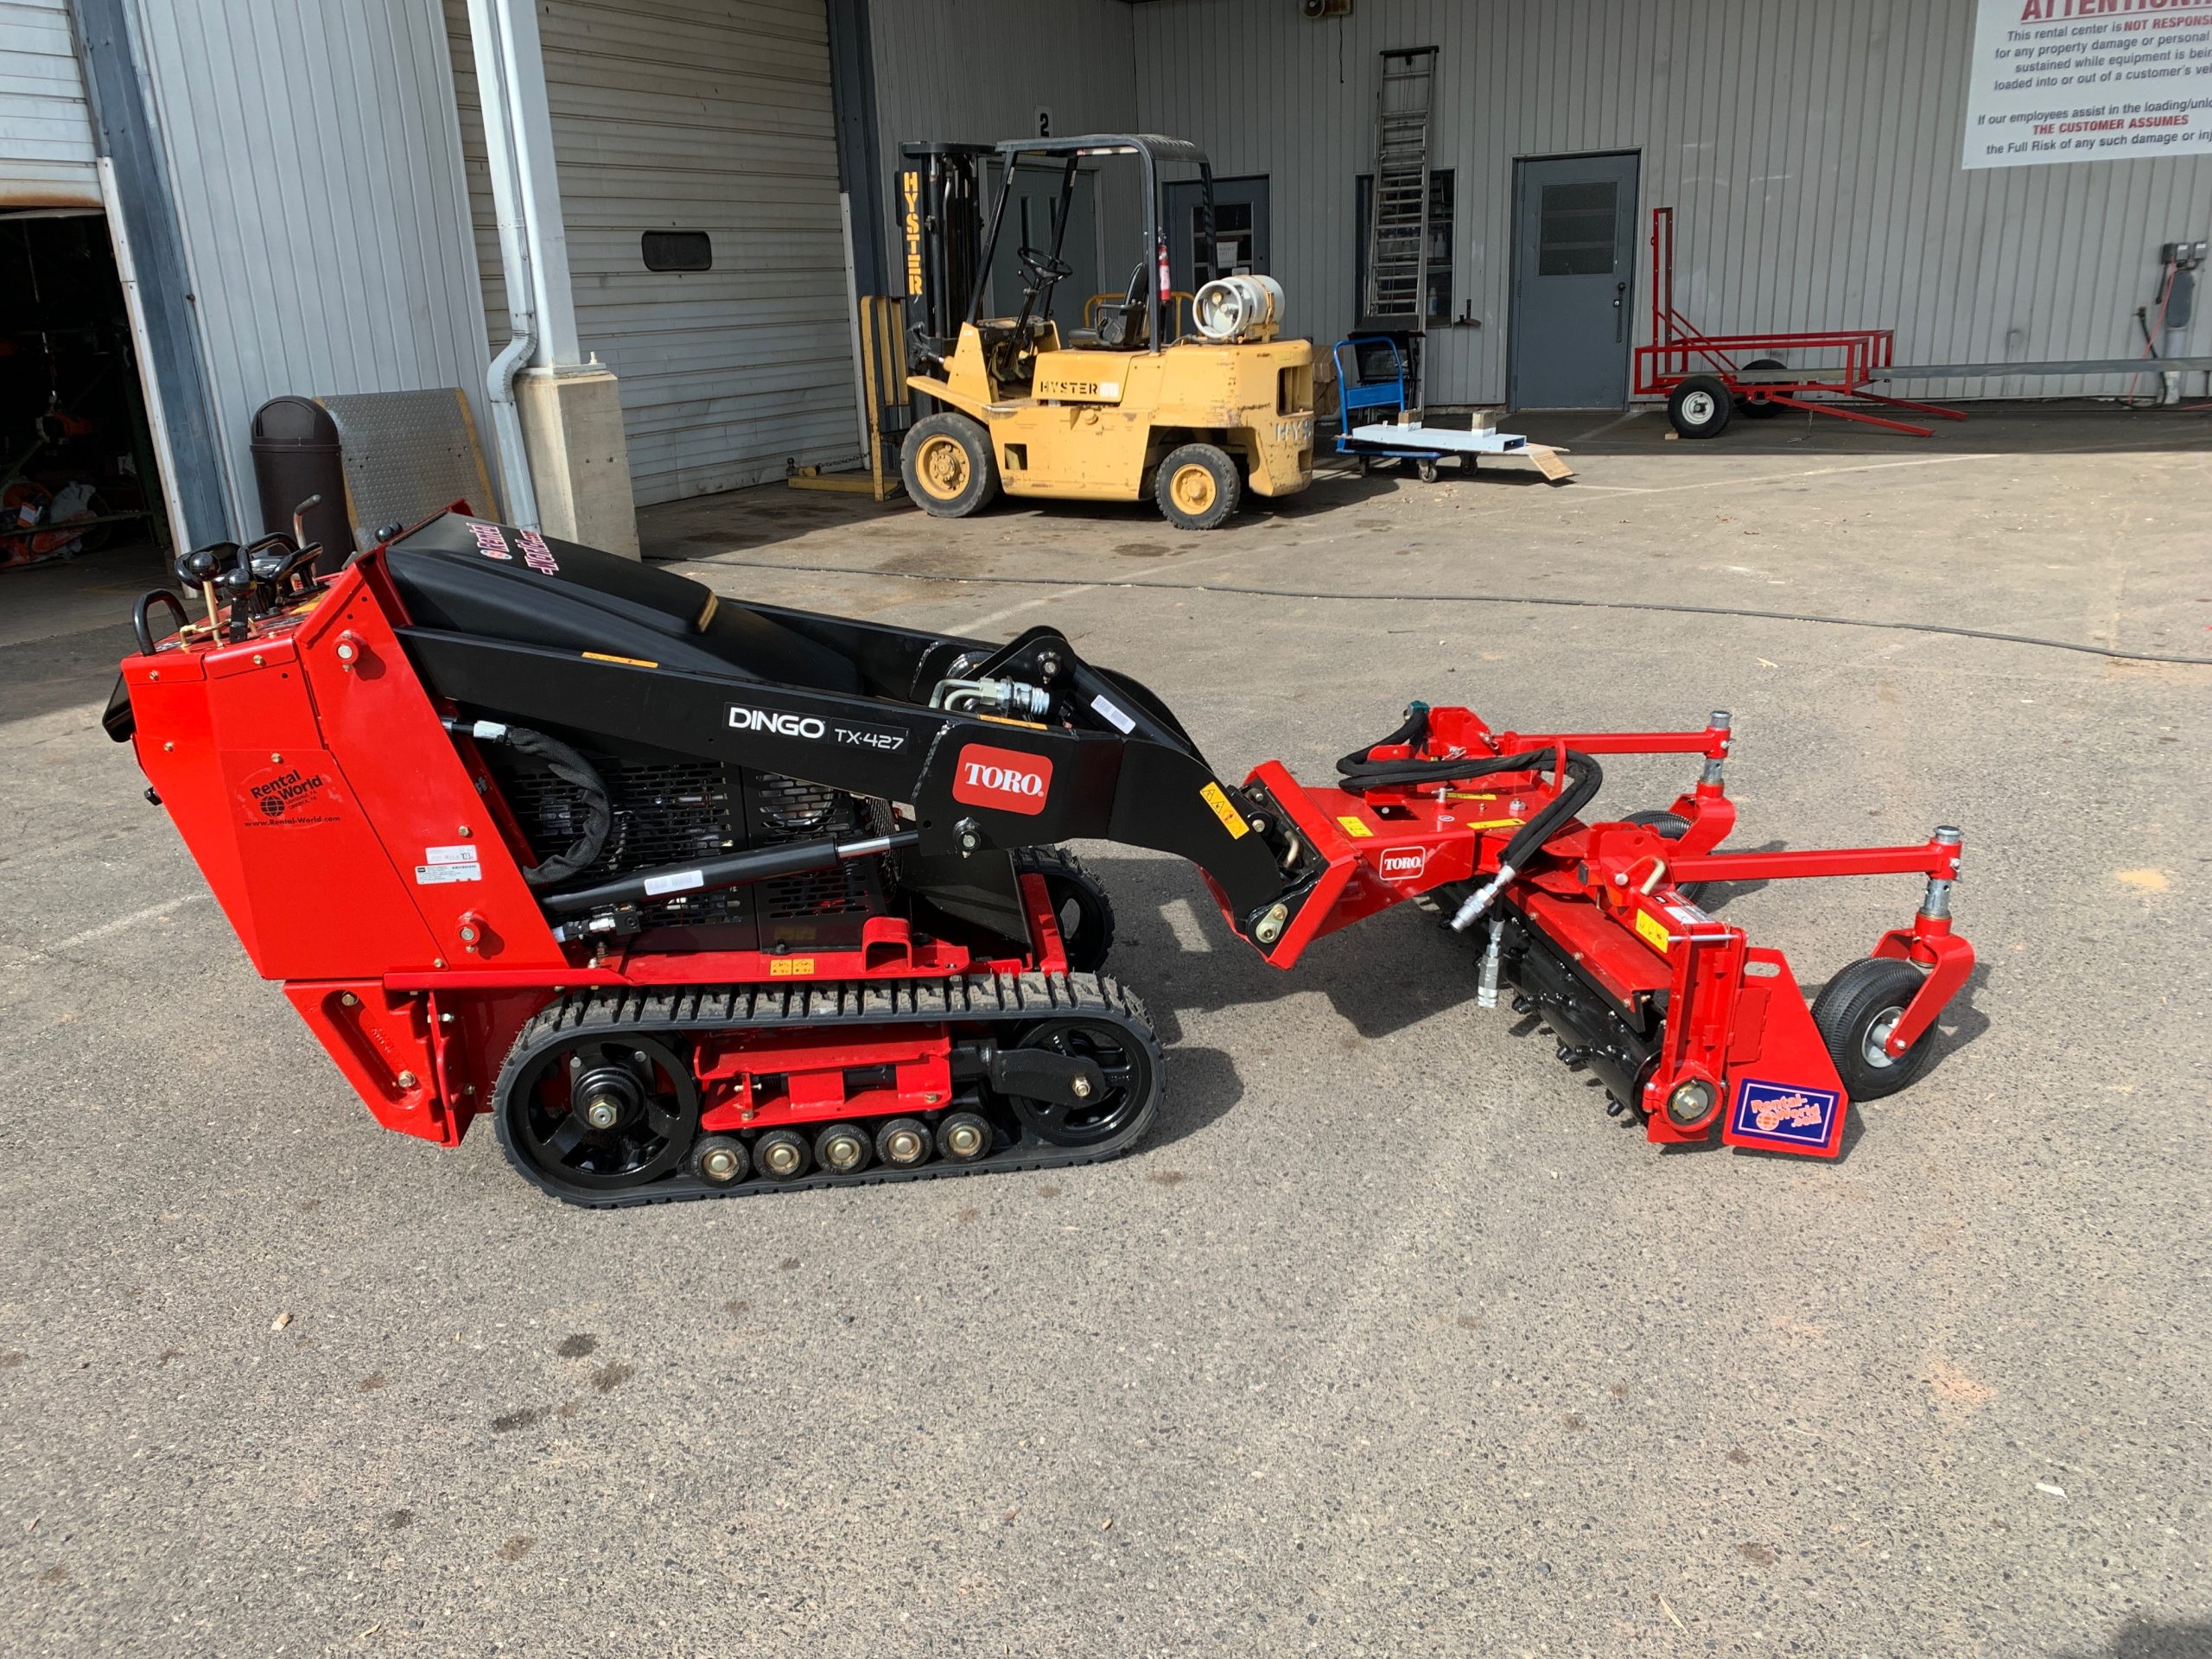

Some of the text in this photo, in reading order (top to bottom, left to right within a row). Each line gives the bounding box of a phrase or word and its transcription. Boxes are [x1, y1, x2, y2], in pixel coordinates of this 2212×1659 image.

[2007, 29, 2031, 41] This
[2035, 26, 2068, 39] rental
[2071, 23, 2108, 35] center
[2112, 22, 2122, 32] is
[2124, 19, 2149, 31] NOT
[1995, 30, 2209, 59] for any property damage or personal
[2015, 58, 2071, 73] sustained
[2075, 54, 2105, 68] while
[2108, 50, 2171, 67] equipment
[2175, 48, 2185, 60] is
[1994, 78, 2032, 91] loaded
[2036, 75, 2057, 87] into
[2061, 75, 2074, 86] or
[2077, 72, 2096, 84] out
[2100, 70, 2112, 82] of
[2115, 72, 2122, 81] a
[2126, 65, 2191, 80] customer's
[1039, 112, 1050, 137] 2
[1978, 114, 1986, 125] If
[1988, 115, 2006, 124] our
[2009, 110, 2068, 124] employees
[2072, 105, 2106, 118] assist
[2108, 105, 2120, 115] in
[2122, 102, 2141, 114] the
[2033, 114, 2189, 135] THE CUSTOMER ASSUMES
[1986, 143, 2004, 155] the
[2007, 141, 2028, 153] Full
[2031, 139, 2056, 151] Risk
[2060, 137, 2073, 149] of
[2075, 138, 2095, 149] any
[2099, 135, 2127, 147] such
[2131, 133, 2177, 145] damage
[2182, 131, 2196, 142] or
[904, 171, 923, 296] HYSTER
[1040, 380, 1098, 395] HYSTER
[466, 522, 510, 553] Rental
[728, 706, 826, 740] DINGO
[250, 769, 302, 799] Rental
[277, 774, 324, 801] World
[964, 762, 1043, 796] TORO
[244, 816, 341, 827] www.Rental-World.com
[1384, 856, 1422, 871] TORO
